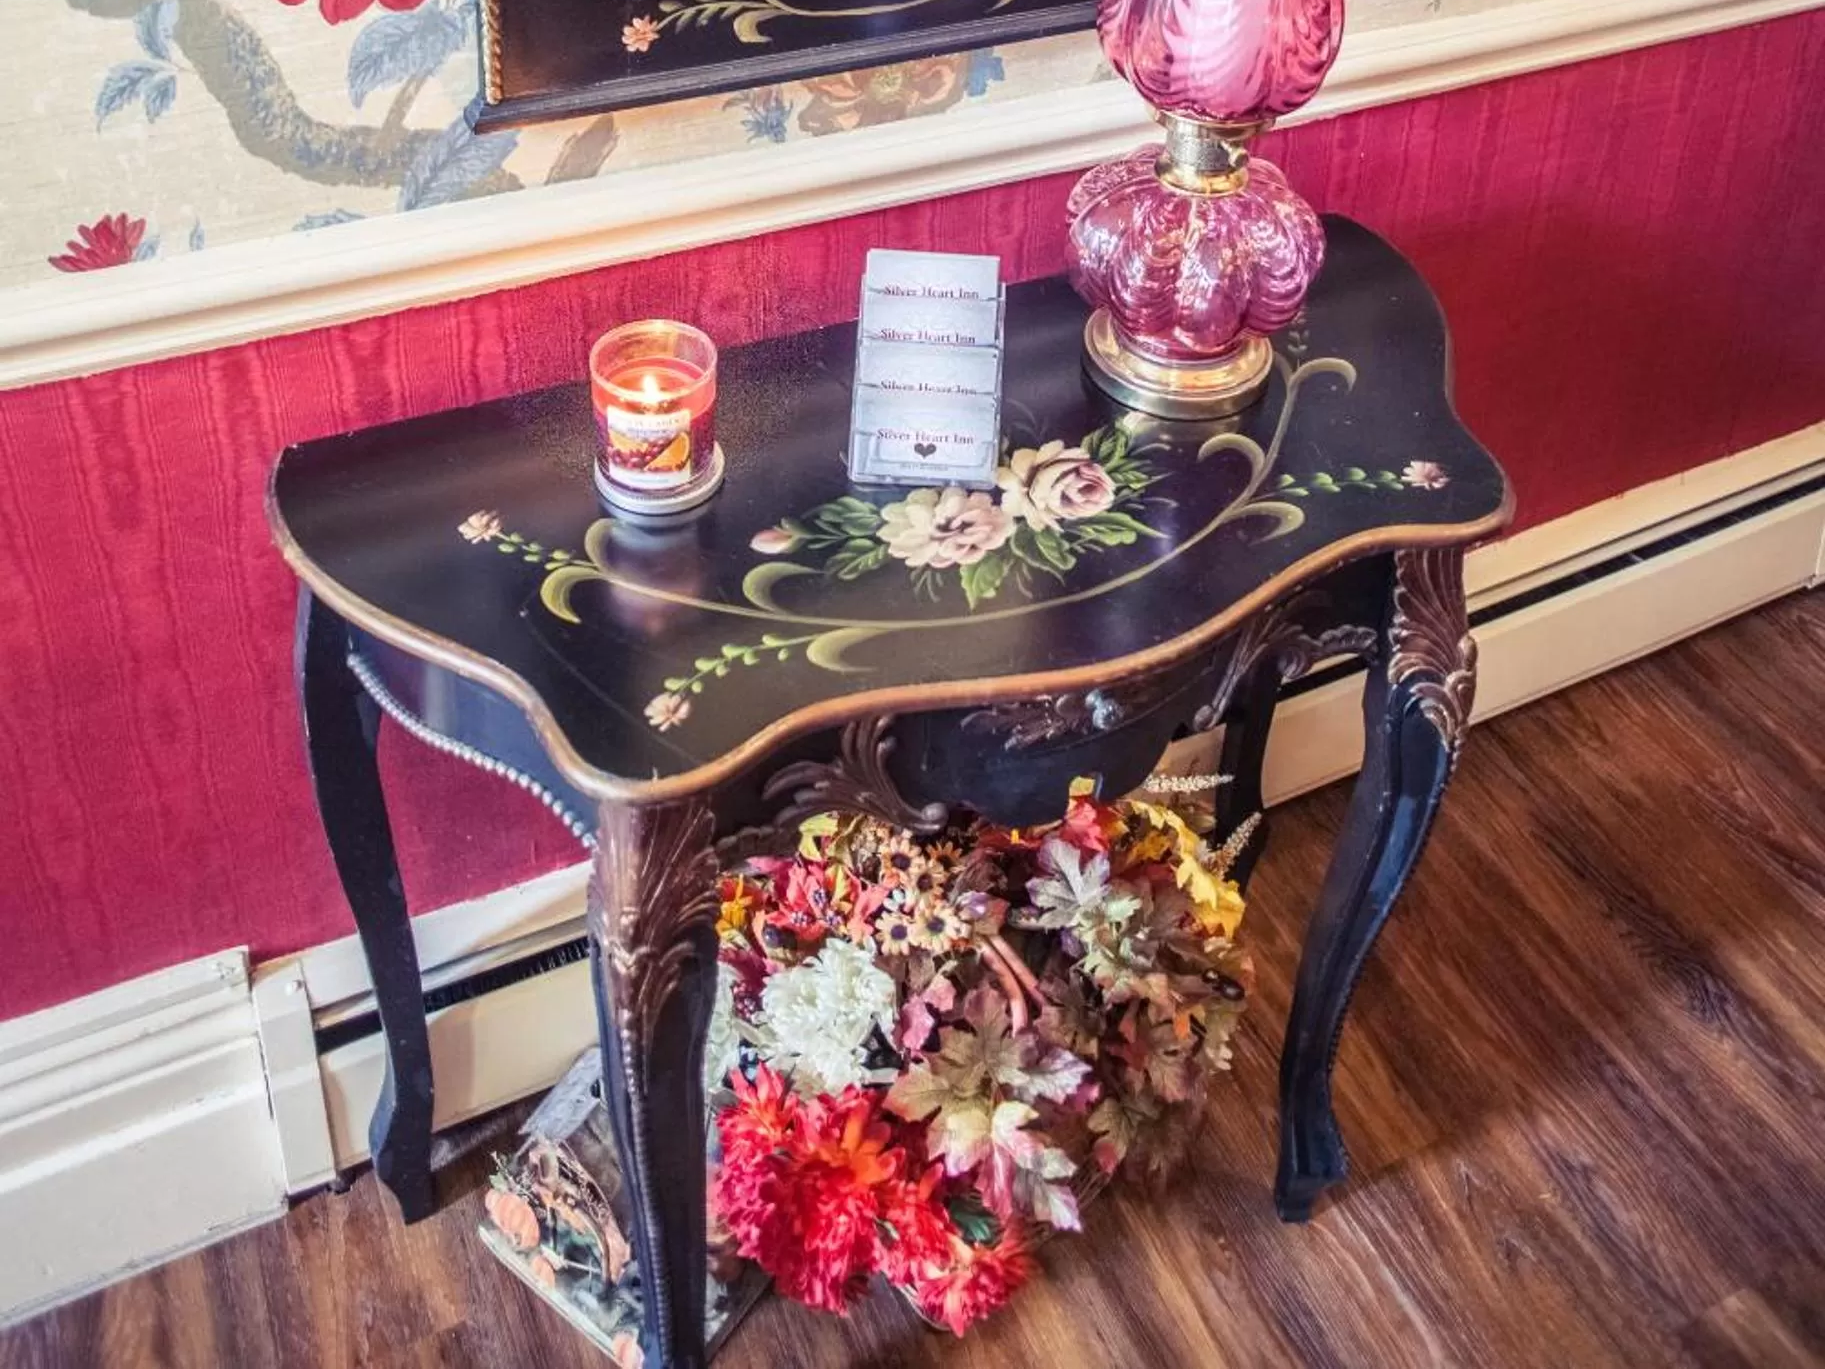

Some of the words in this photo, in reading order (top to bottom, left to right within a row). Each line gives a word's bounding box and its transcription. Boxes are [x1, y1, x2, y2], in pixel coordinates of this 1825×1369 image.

[883, 284, 918, 297] Silver
[922, 287, 954, 299] Heart
[958, 289, 980, 300] Inn
[880, 328, 915, 341] Silver
[919, 330, 950, 343] Heart
[956, 332, 977, 345] Inn
[877, 428, 910, 440] Silver
[915, 430, 949, 443] Heart
[953, 434, 974, 445] Inn
